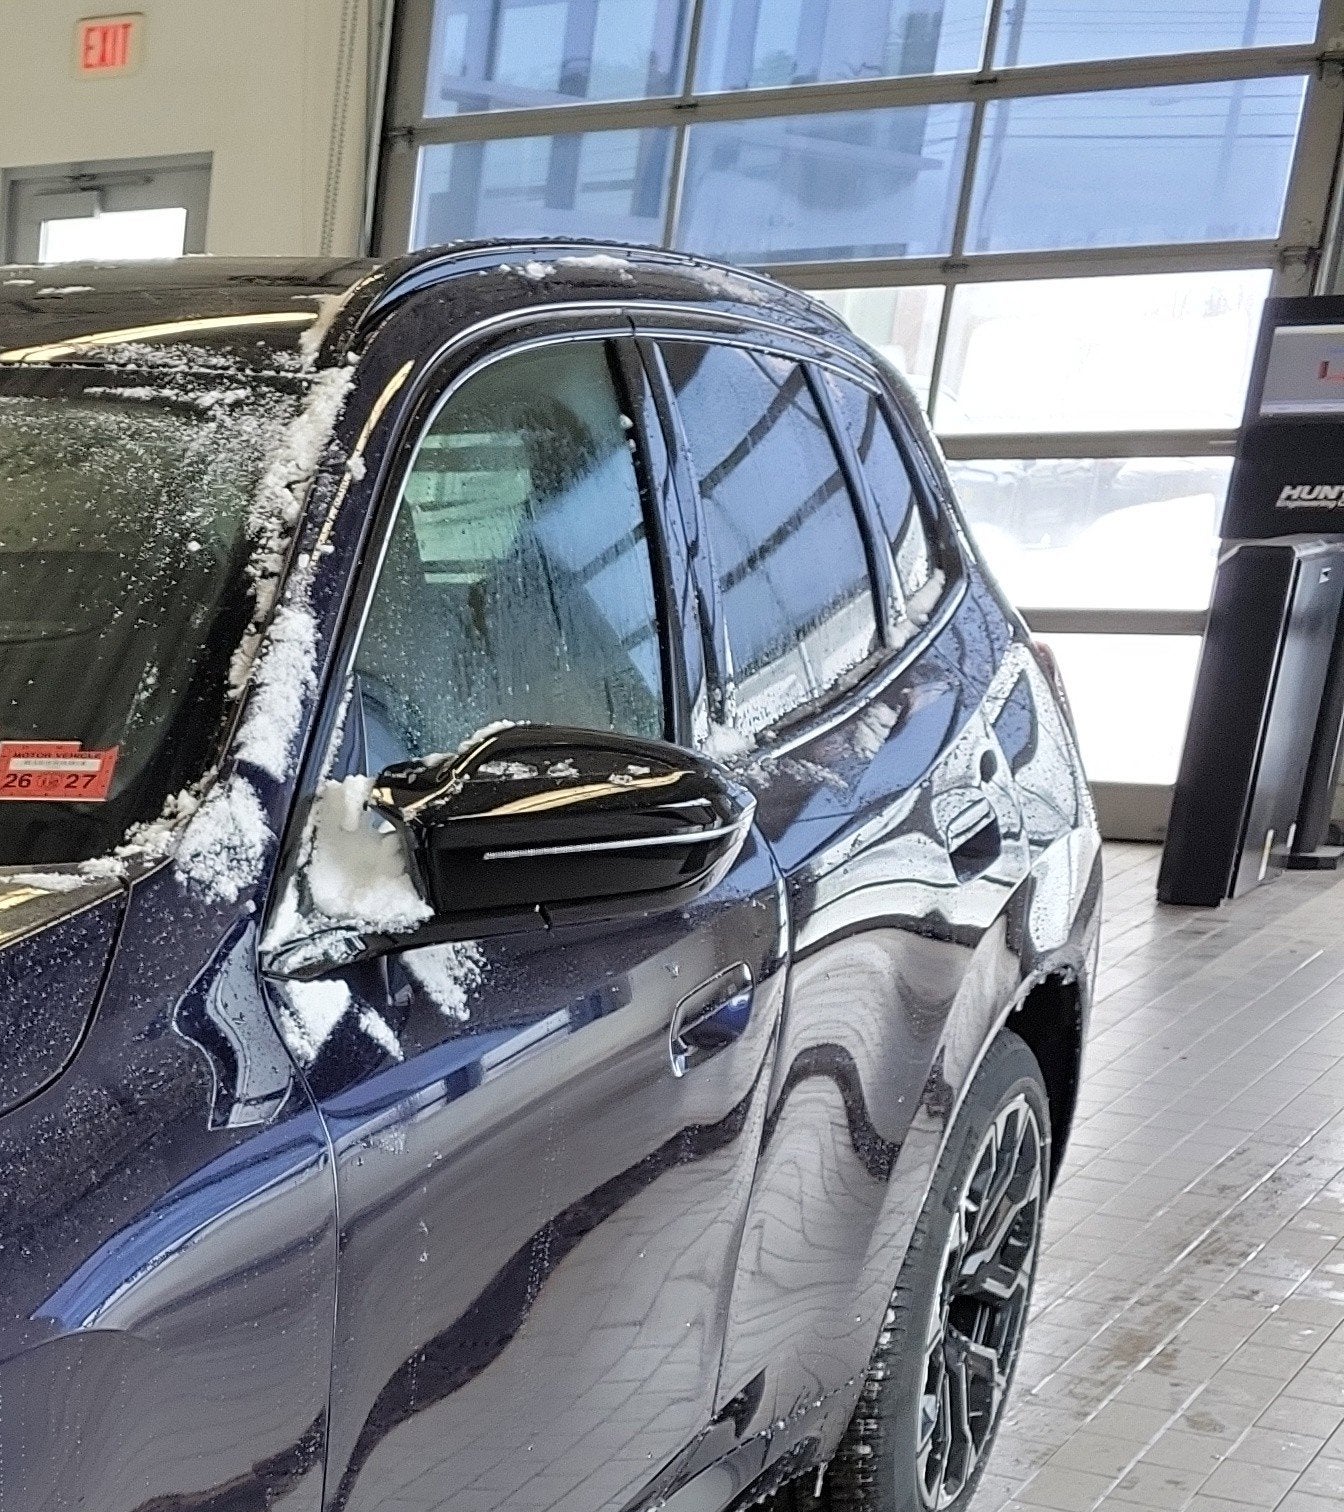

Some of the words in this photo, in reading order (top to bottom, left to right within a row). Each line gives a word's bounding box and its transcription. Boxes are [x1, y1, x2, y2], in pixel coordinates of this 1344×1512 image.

[83, 23, 131, 68] EXIT
[4, 773, 32, 788] 26
[64, 774, 97, 789] 27
